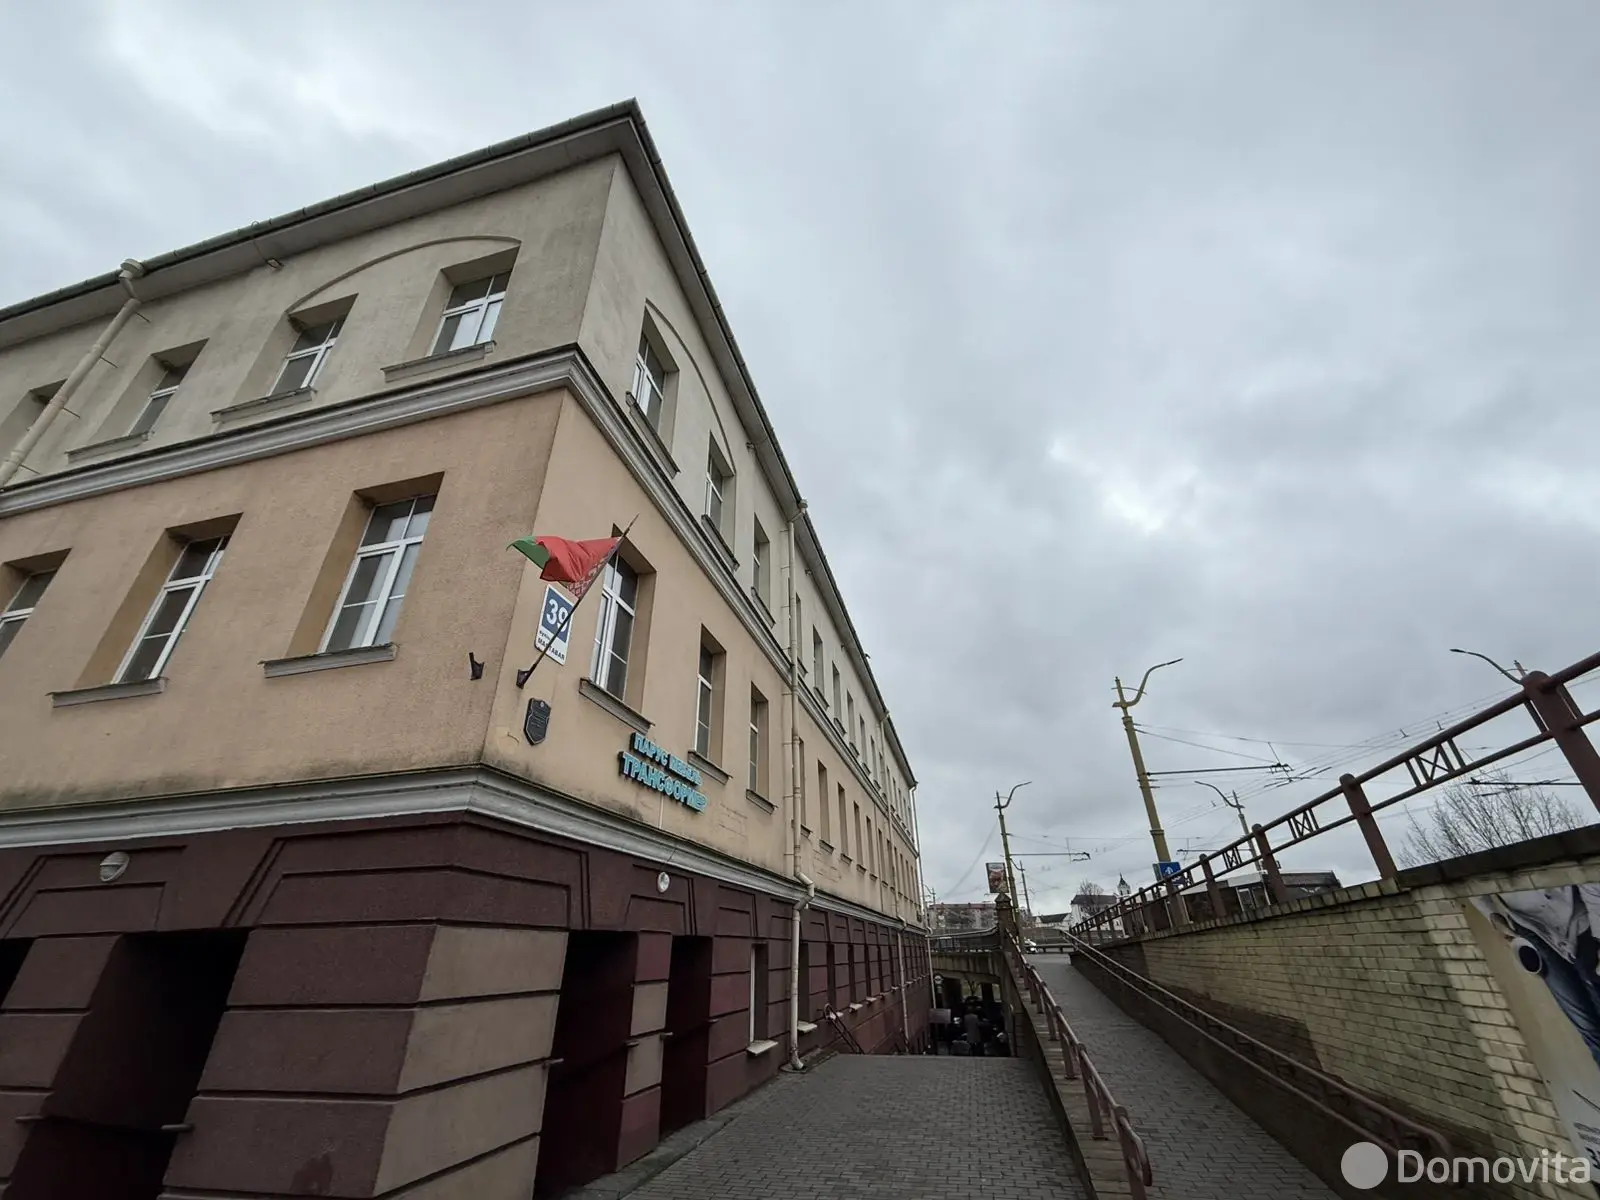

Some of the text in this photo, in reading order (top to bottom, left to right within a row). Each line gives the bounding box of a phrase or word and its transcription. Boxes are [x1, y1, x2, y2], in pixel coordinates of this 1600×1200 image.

[546, 598, 569, 633] 39
[633, 732, 669, 767] ПАРУС
[623, 751, 709, 814] ТРАНСФОРМЕР
